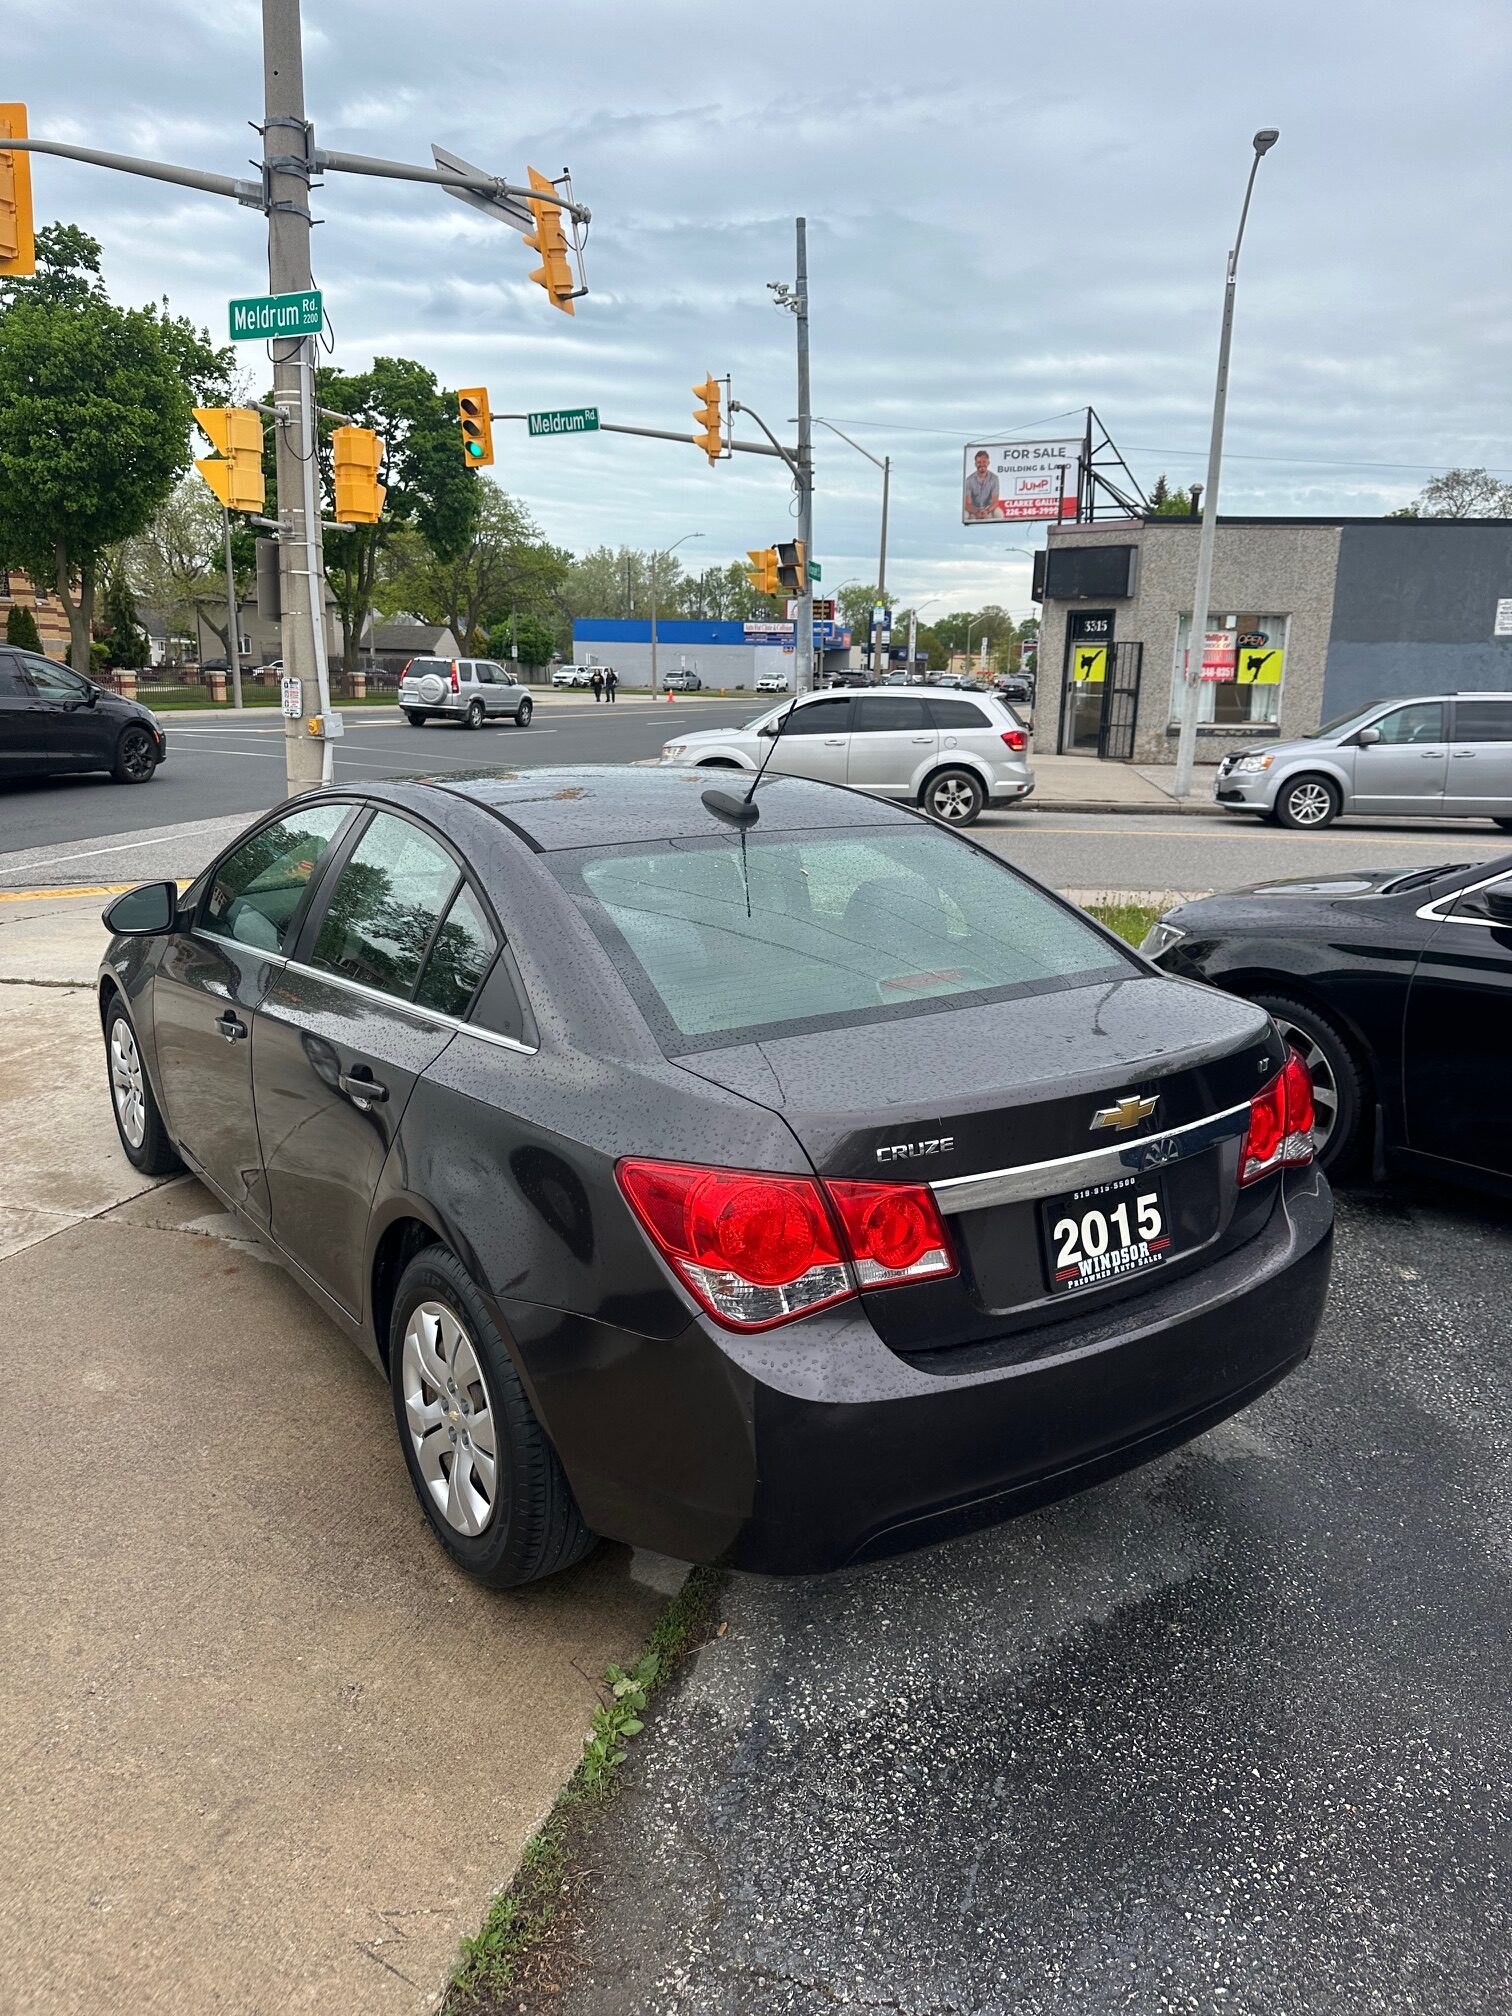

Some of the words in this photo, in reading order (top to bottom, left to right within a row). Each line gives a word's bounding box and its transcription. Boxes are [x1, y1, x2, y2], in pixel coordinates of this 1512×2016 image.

[234, 304, 299, 331] Meldrum
[302, 298, 318, 312] Rd.
[303, 313, 318, 324] 2200
[530, 413, 585, 434] Meldrum
[584, 410, 597, 421] Rd.
[1003, 449, 1030, 460] FOR
[1034, 447, 1066, 458] SALE
[1040, 463, 1046, 471] &
[1004, 500, 1034, 508] CLARKE
[1084, 619, 1108, 632] 3315
[1239, 634, 1265, 645] OPEN
[876, 1137, 955, 1163] CRUZE
[1074, 1177, 1136, 1200] 519-915-5500
[1053, 1192, 1162, 1269] 2015
[1078, 1241, 1150, 1277] WINDSOR
